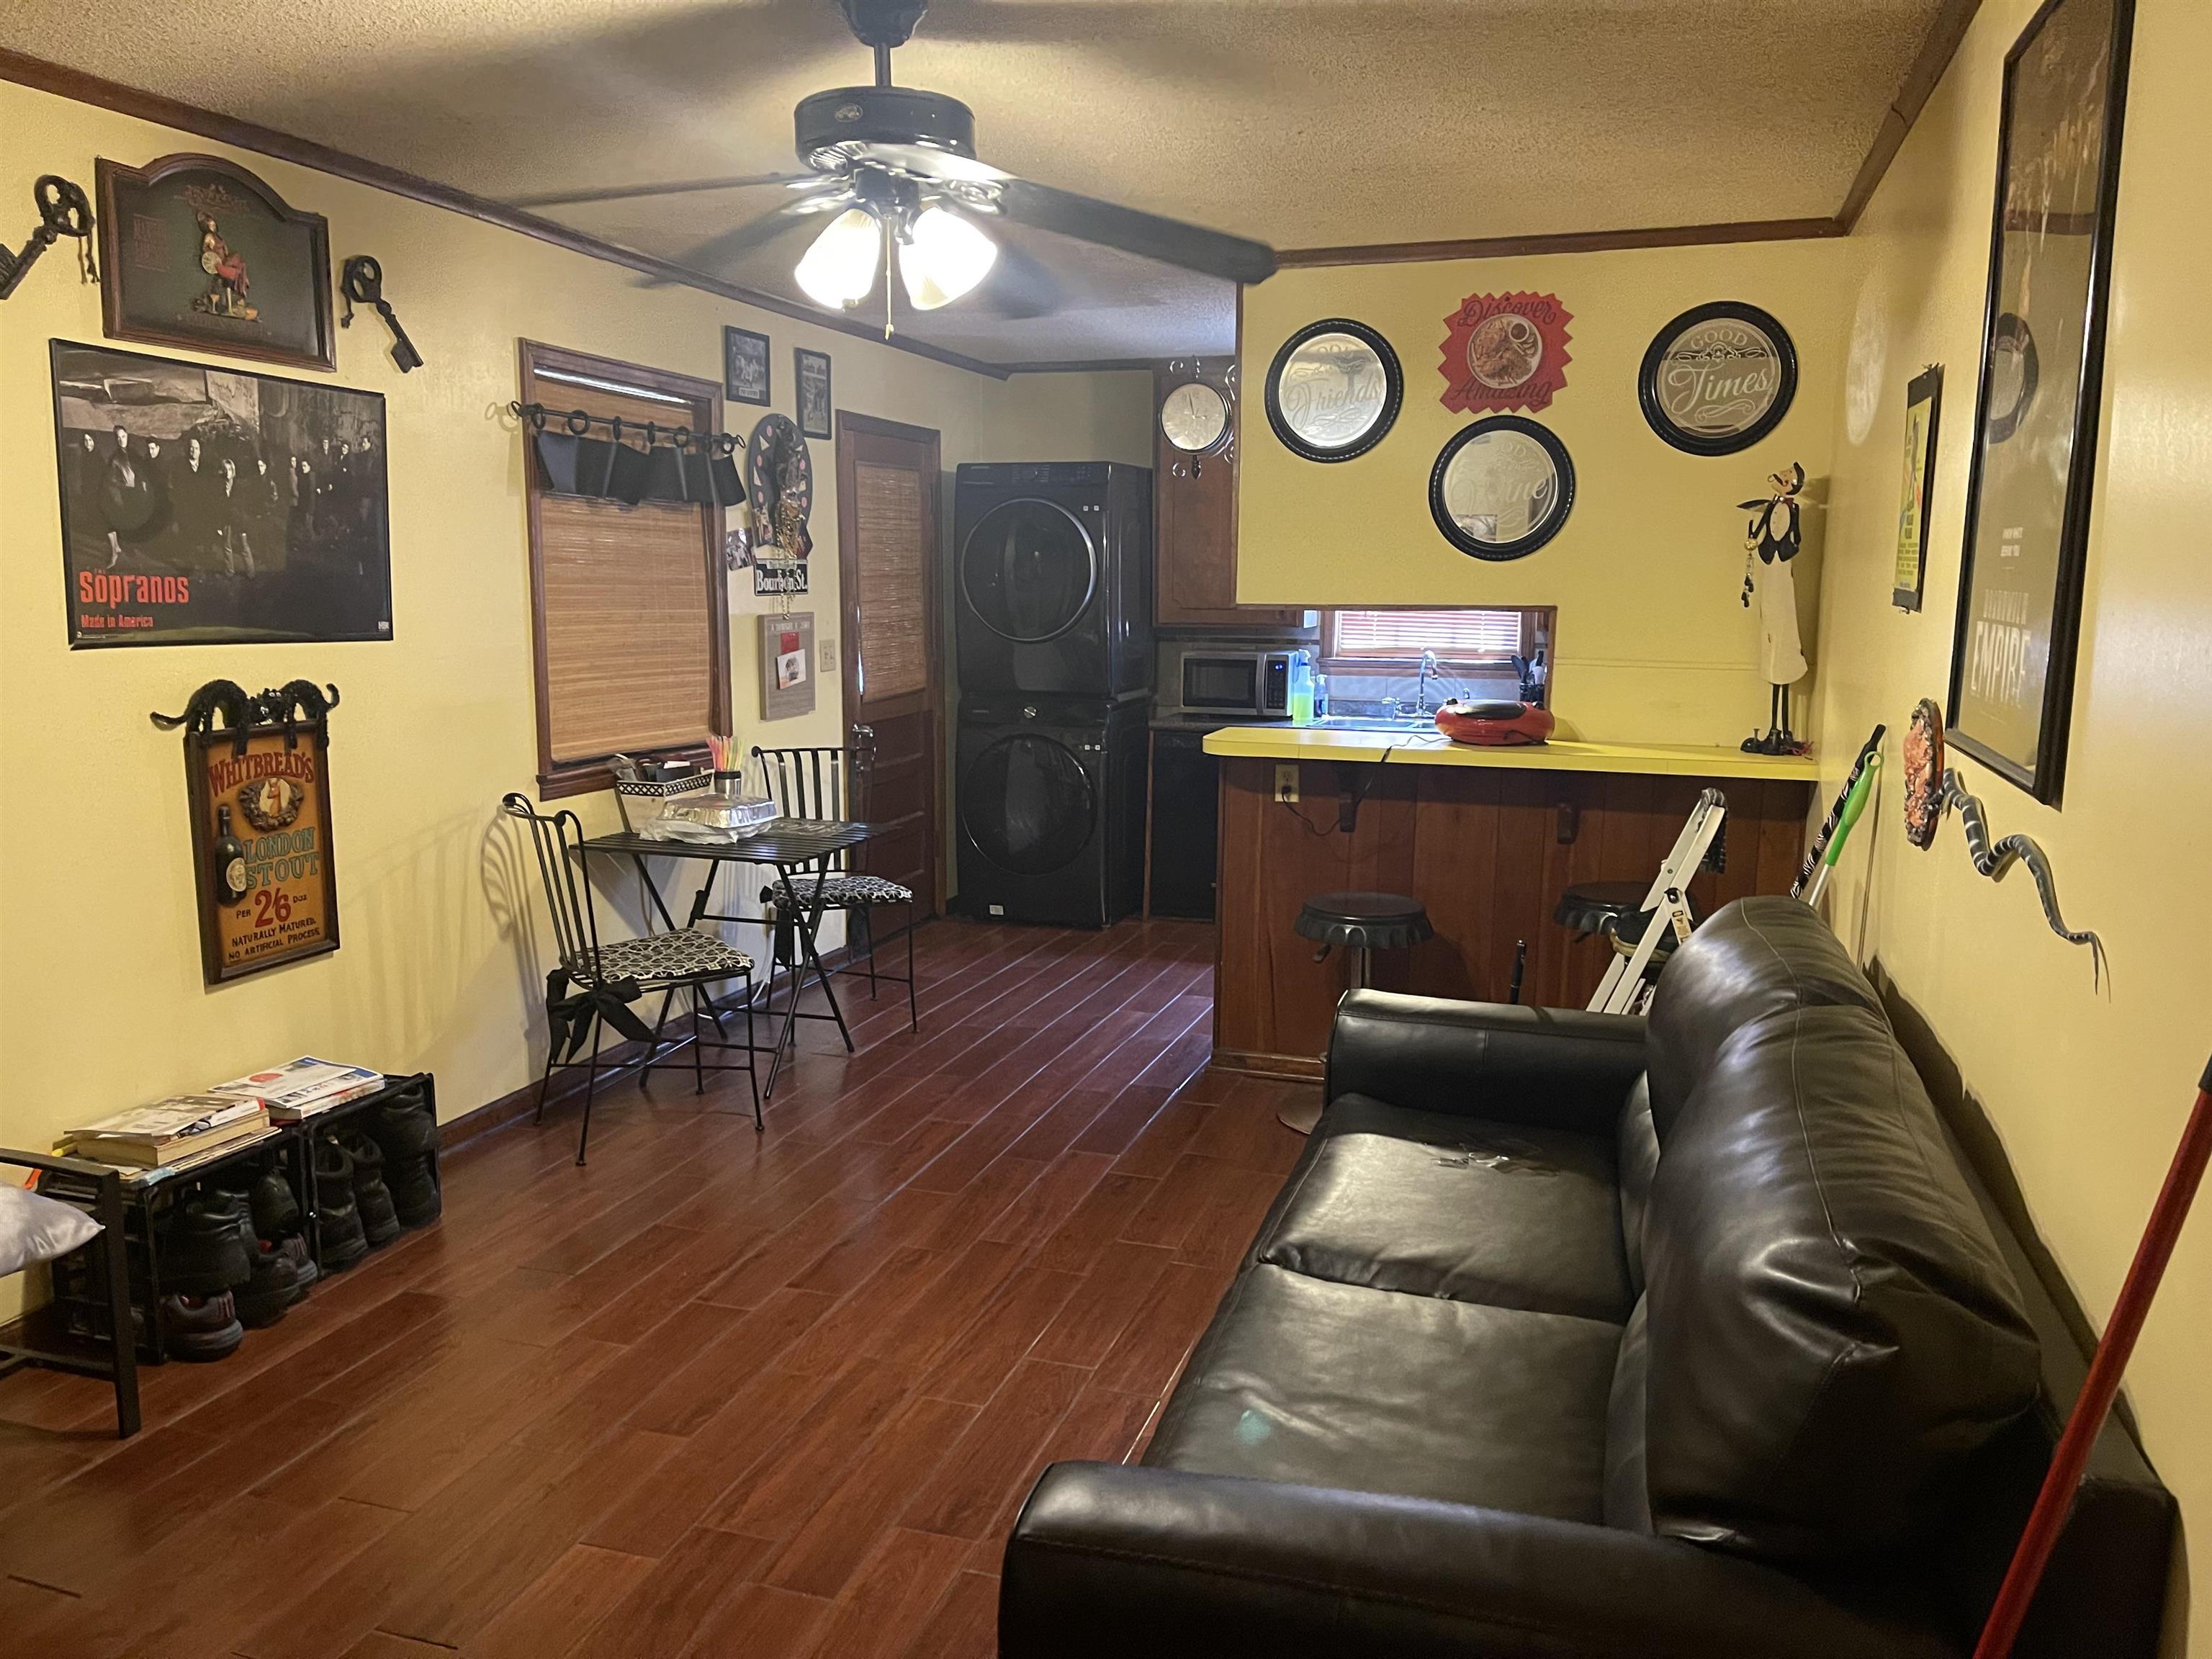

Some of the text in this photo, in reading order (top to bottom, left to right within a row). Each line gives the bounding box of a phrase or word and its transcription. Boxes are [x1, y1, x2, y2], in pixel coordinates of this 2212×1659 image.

[1457, 297, 1556, 326] Discover
[1691, 330, 1747, 349] GOOD
[1284, 373, 1381, 430] Friends
[1668, 363, 1773, 415] Times
[79, 571, 189, 609] Sopranos
[756, 569, 794, 592] Bourbon
[81, 614, 153, 628] Made in America
[1971, 620, 2031, 709] EMPIRE
[208, 751, 314, 797] WHITBREAD'S
[243, 826, 315, 864] LONDON
[246, 851, 320, 889] STOUT
[236, 909, 251, 920] PER
[228, 950, 240, 960] NO
[245, 939, 284, 956] ARTIFICIAL
[232, 927, 276, 948] NATURALLY
